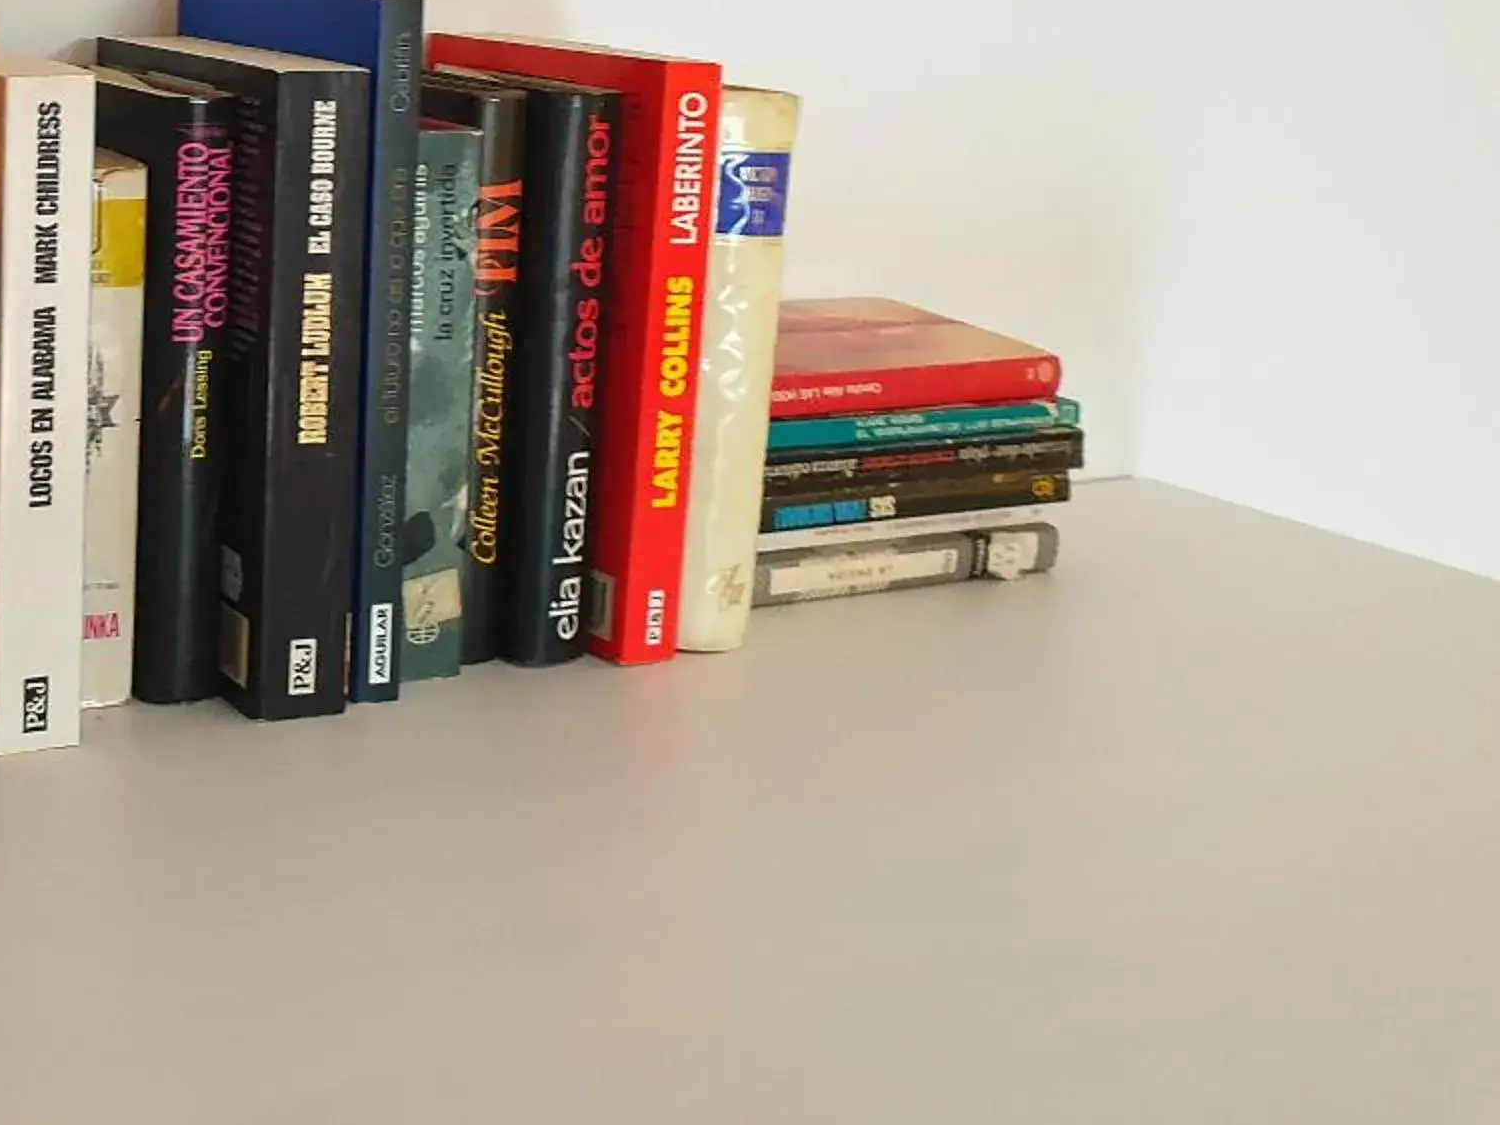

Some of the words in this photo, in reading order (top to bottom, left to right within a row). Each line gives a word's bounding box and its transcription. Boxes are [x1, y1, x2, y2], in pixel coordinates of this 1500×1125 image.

[33, 101, 62, 216] CHILDRESS
[311, 99, 337, 175] BOURNE
[584, 114, 613, 226] amor
[669, 91, 710, 246] LABERINTO
[172, 141, 209, 303] CASAMIENTO
[204, 143, 234, 329] CONVENCIONAL
[308, 178, 334, 227] CASO
[32, 222, 60, 285] MARK
[307, 231, 330, 256] EL
[581, 236, 606, 288] de
[31, 305, 57, 402] ALABAMA
[172, 305, 204, 343] UN
[571, 298, 600, 409] actos
[660, 275, 694, 398] COLLINS
[193, 349, 213, 408] Lessing
[298, 360, 328, 445] ROBERT
[475, 309, 514, 465] McCullough
[31, 407, 55, 432] EN
[189, 411, 206, 460] Doris
[29, 437, 55, 509] LOCOS
[651, 409, 684, 509] LARRY
[471, 477, 500, 566] Colleen
[552, 451, 590, 567] kazan
[374, 607, 391, 679] AGUILAR
[548, 574, 582, 641] elia
[23, 676, 49, 733] P&J
[290, 640, 317, 695] P&J
